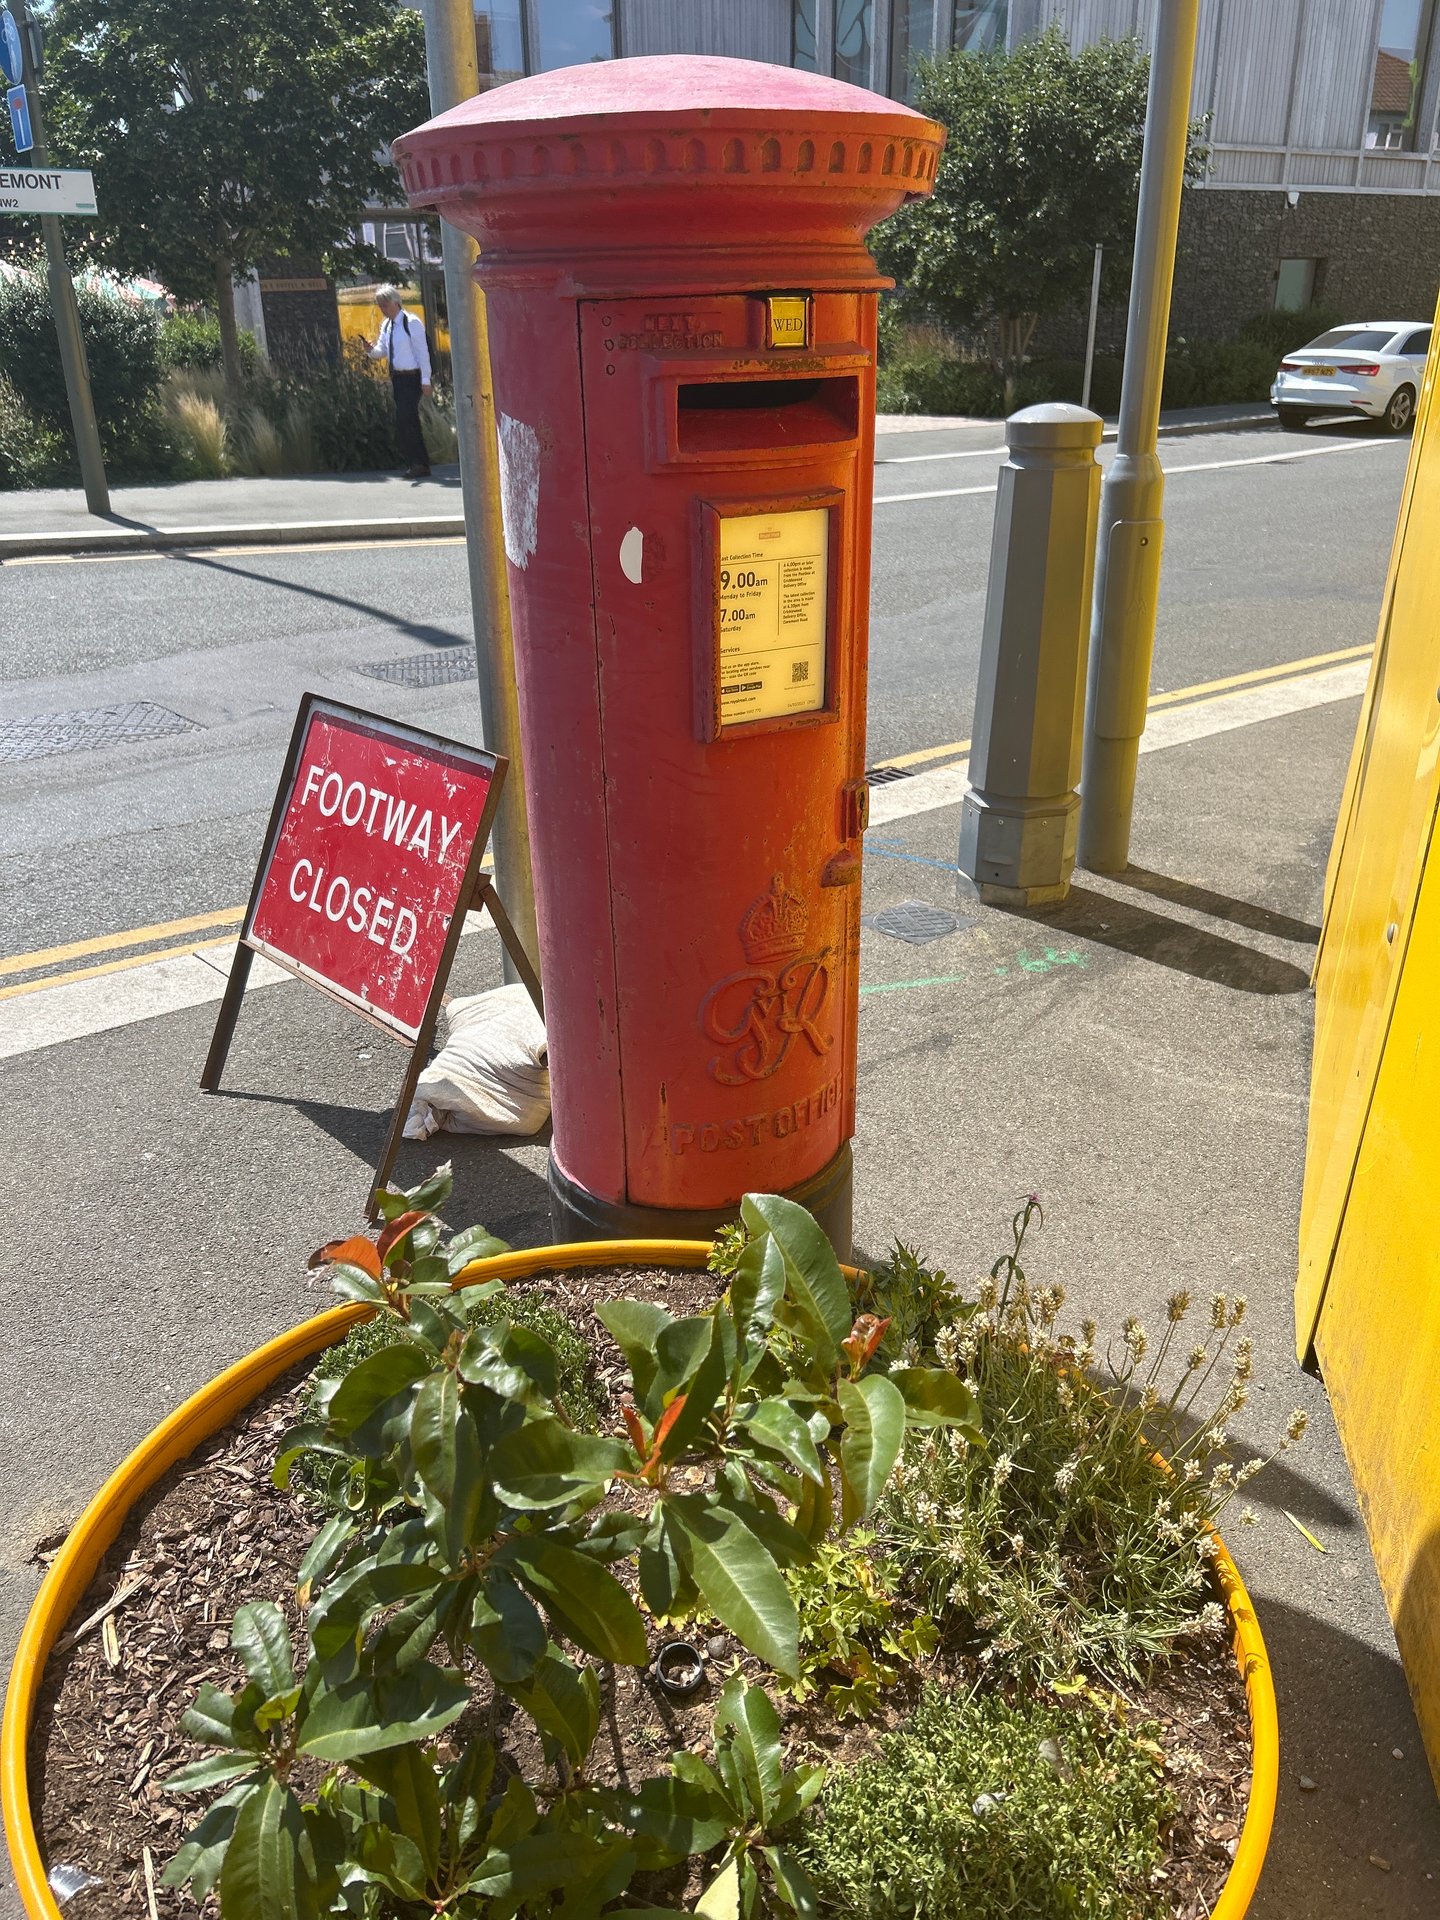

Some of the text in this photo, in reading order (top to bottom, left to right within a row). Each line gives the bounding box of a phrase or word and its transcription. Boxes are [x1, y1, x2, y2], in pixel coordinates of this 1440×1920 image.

[773, 318, 803, 332] WED
[720, 570, 768, 590] 9.00am
[720, 608, 756, 622] 7.00am
[301, 764, 462, 865] FOOTWAY
[289, 858, 417, 955] CLOSED
[672, 1112, 767, 1155] POST
